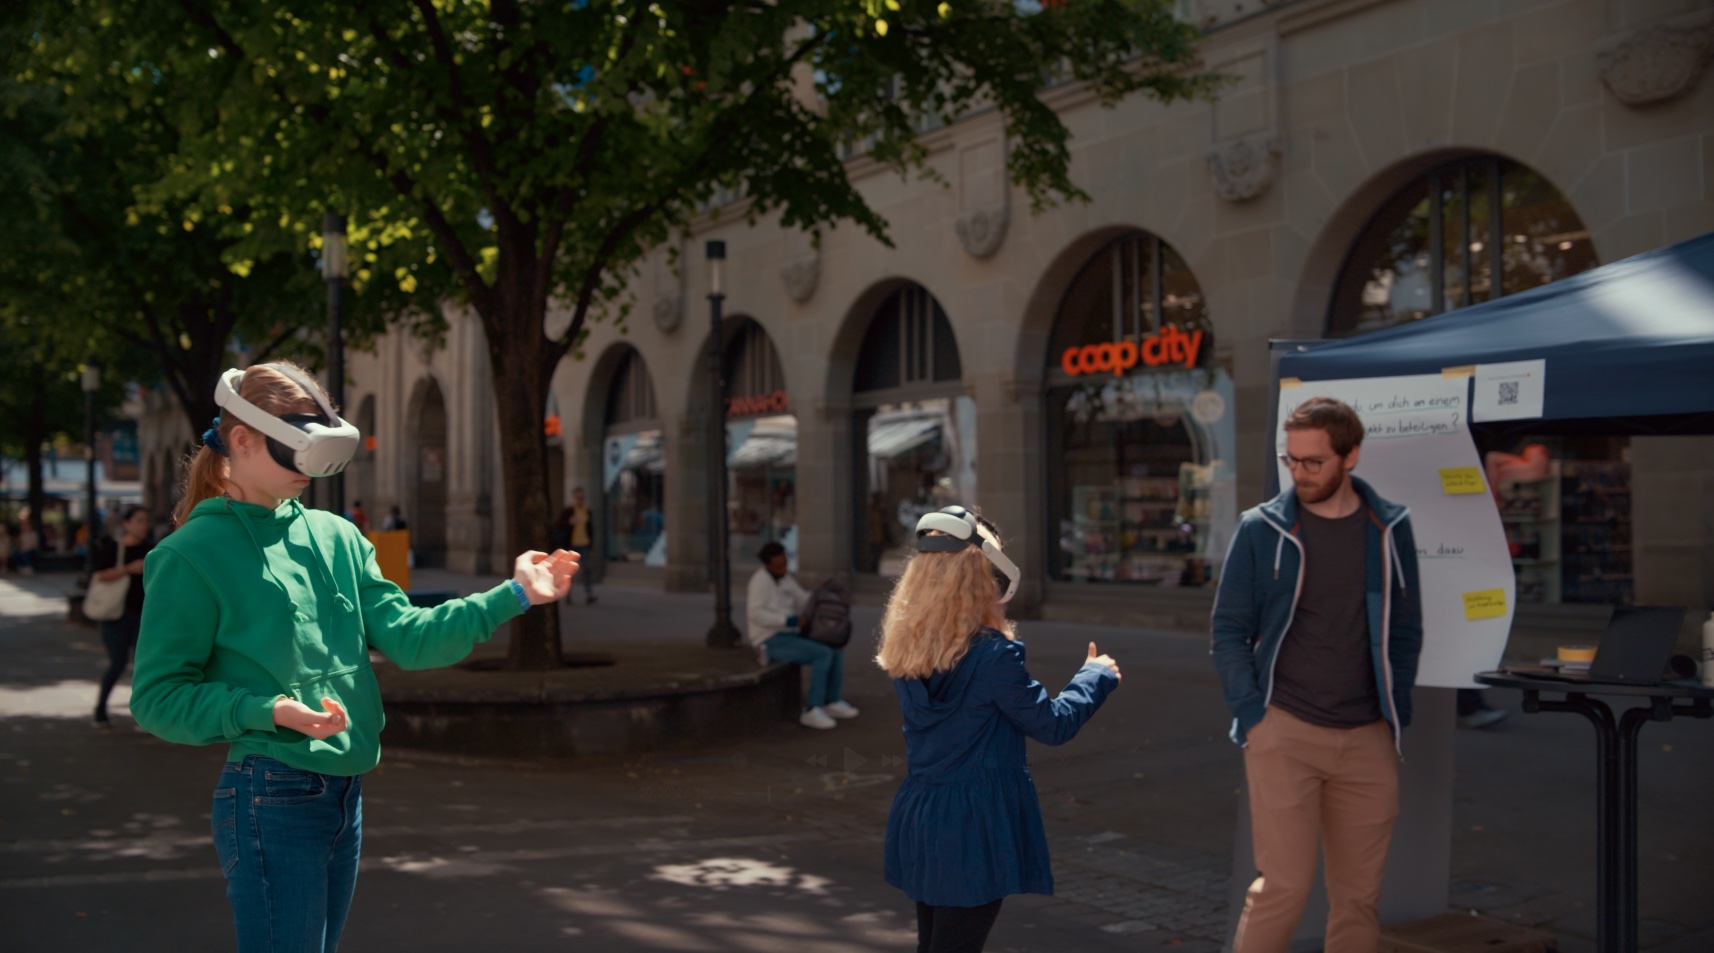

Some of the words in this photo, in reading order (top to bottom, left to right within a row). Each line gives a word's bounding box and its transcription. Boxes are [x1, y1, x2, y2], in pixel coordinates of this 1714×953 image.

[1062, 341, 1138, 377] coop
[1141, 325, 1203, 369] city
[1388, 394, 1409, 409] dich
[1414, 398, 1425, 406] an
[1428, 395, 1460, 406] einem
[1399, 419, 1448, 434] beteiligen
